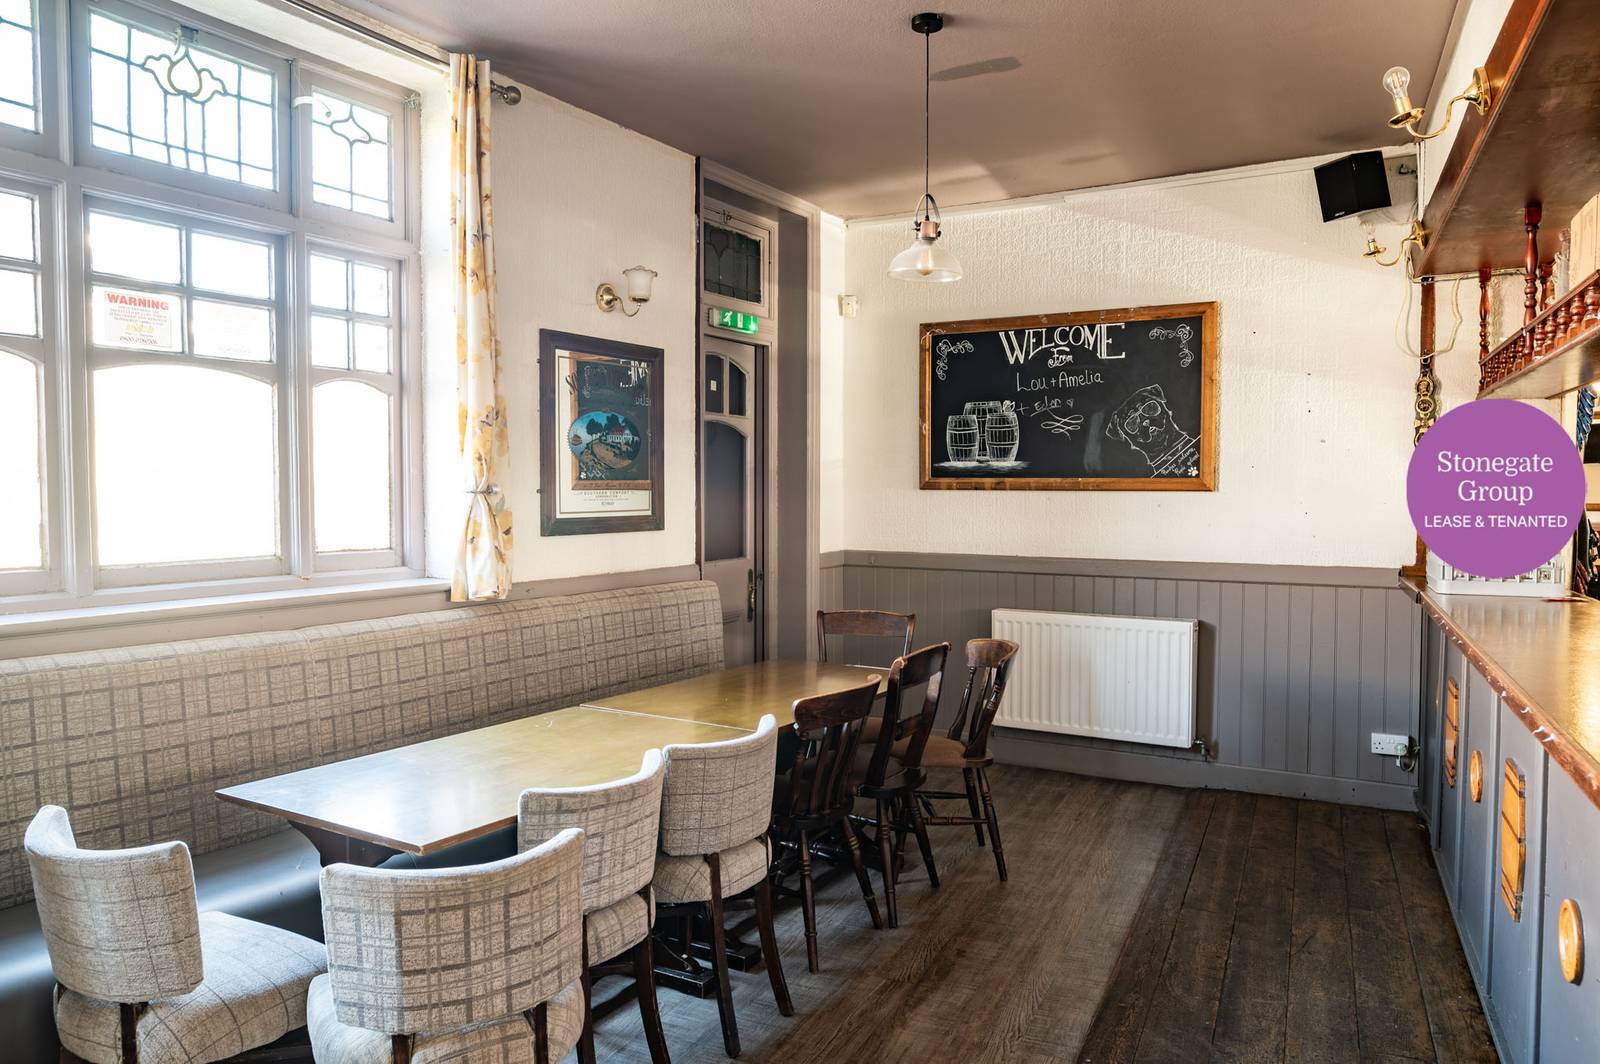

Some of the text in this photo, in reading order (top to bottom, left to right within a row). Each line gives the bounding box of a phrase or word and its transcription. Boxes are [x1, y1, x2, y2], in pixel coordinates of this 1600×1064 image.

[107, 293, 169, 311] WARNING
[999, 322, 1126, 365] WELCOME
[1058, 369, 1105, 388] Amelia
